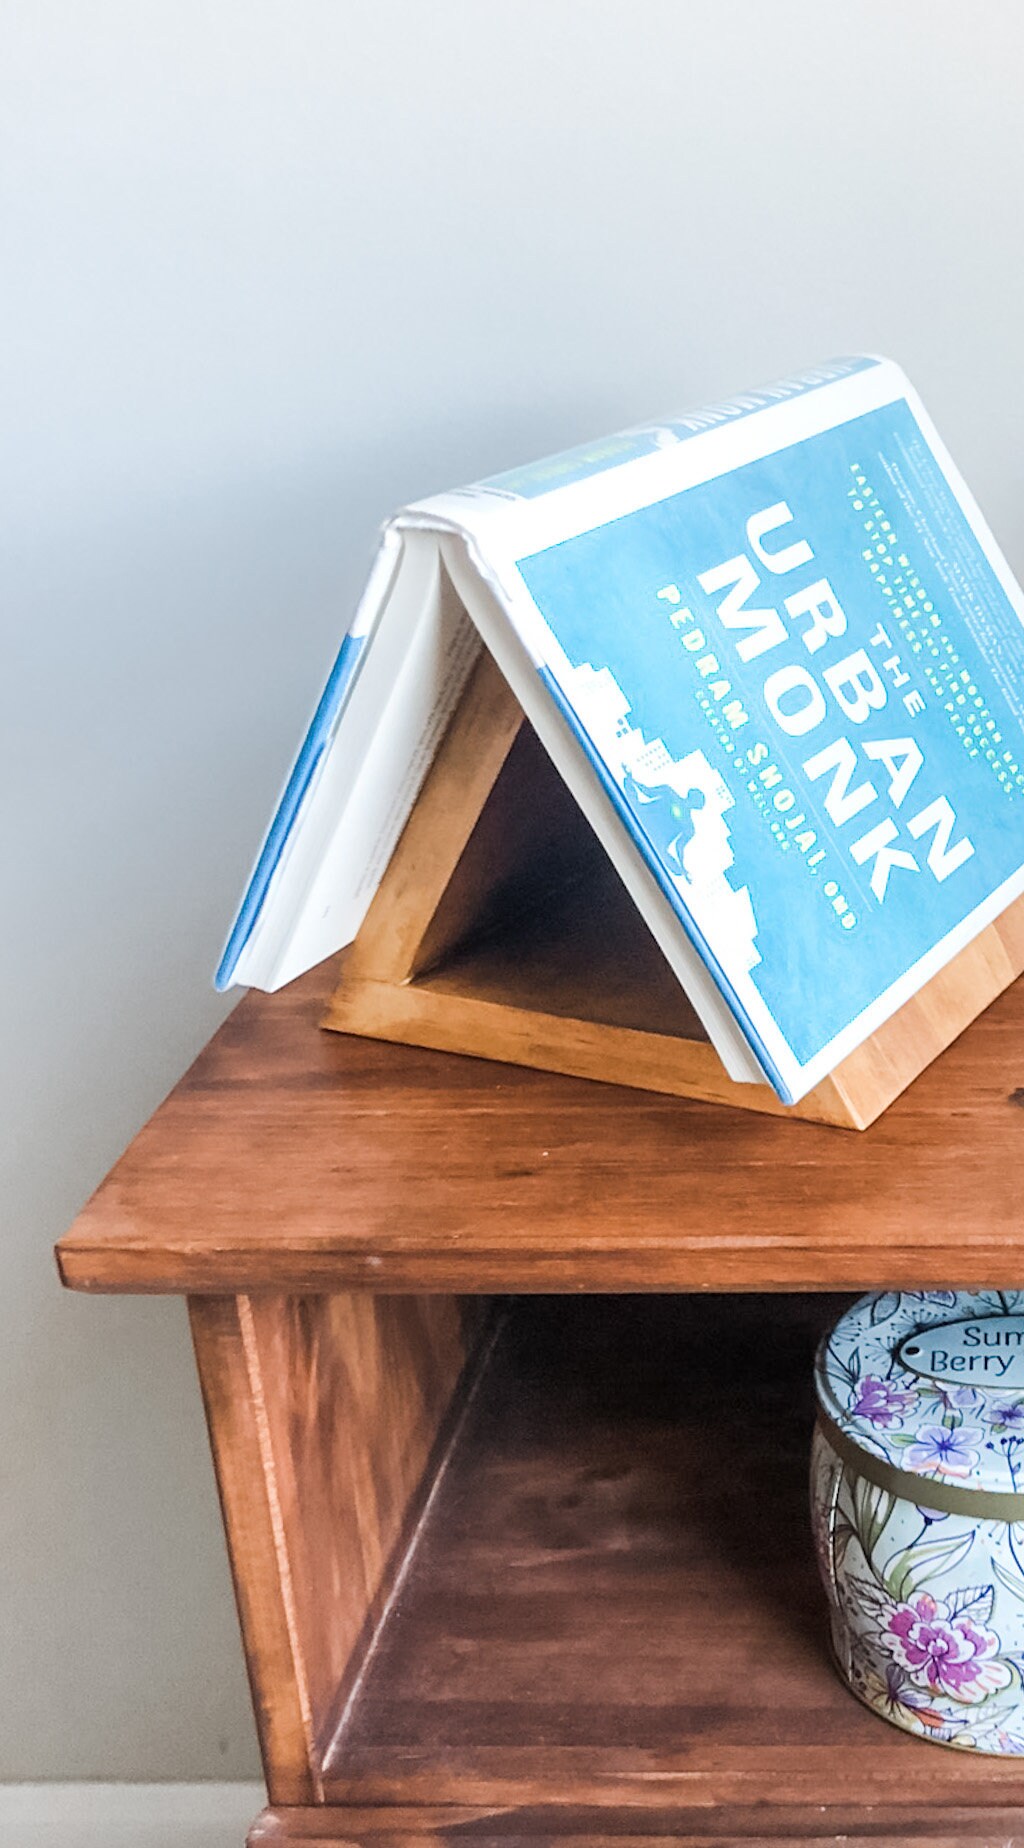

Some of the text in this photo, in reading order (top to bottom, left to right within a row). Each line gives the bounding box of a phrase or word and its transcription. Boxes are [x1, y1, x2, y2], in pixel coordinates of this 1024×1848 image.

[656, 583, 749, 739] PEDRAM
[744, 736, 827, 878] SHOJAI,
[695, 545, 921, 905] MONK
[745, 500, 975, 883] URBAN
[868, 621, 926, 718] THE
[930, 1350, 1015, 1377] Berry
